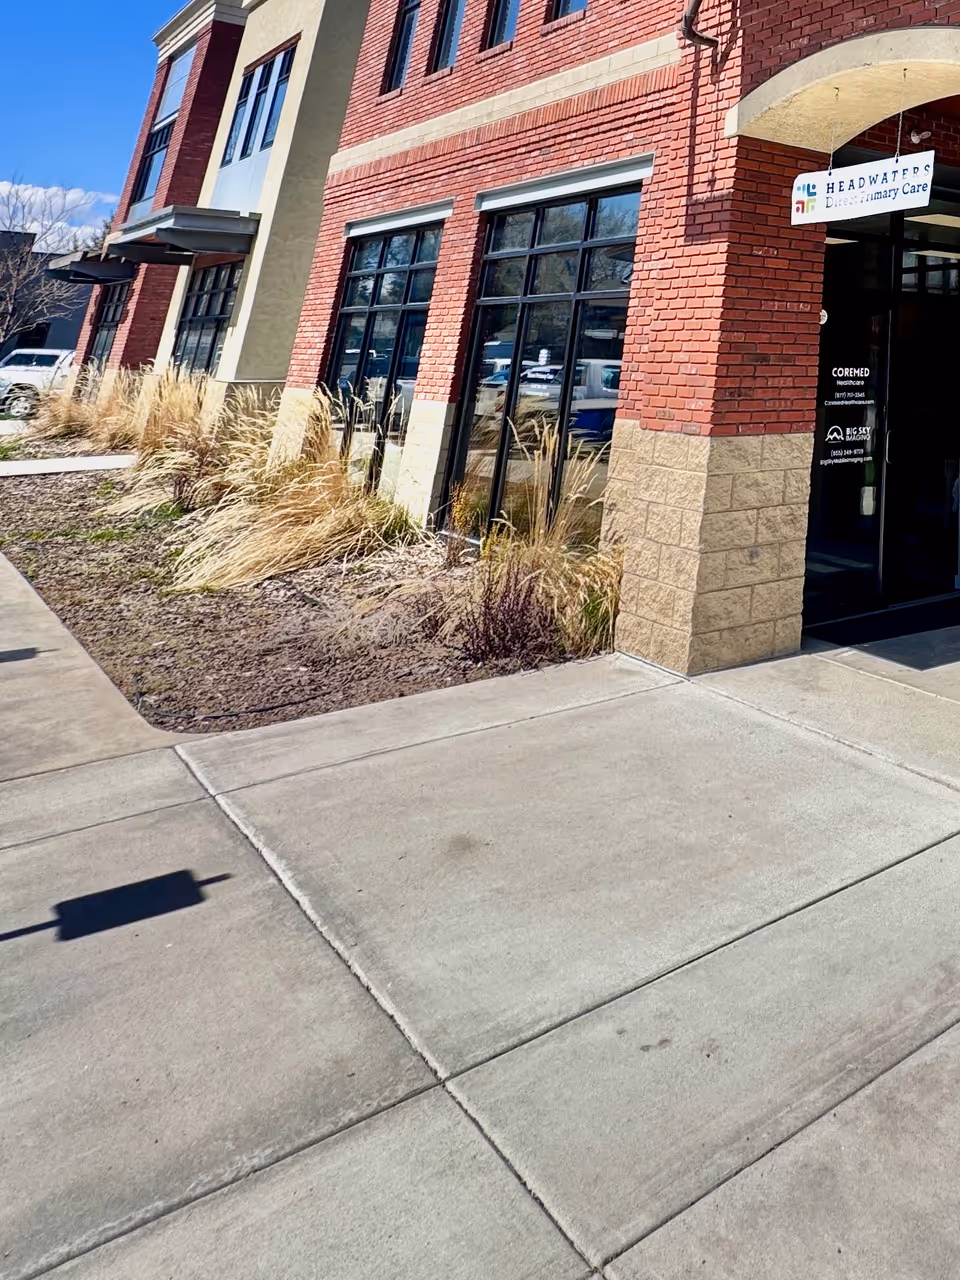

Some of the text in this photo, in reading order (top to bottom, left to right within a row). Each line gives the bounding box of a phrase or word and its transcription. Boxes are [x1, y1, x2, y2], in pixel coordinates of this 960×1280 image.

[825, 164, 931, 194] HEADWATERS
[860, 187, 899, 204] Primary
[902, 182, 928, 195] Care
[832, 367, 870, 377] COREMED
[845, 426, 871, 435] BIG SKY
